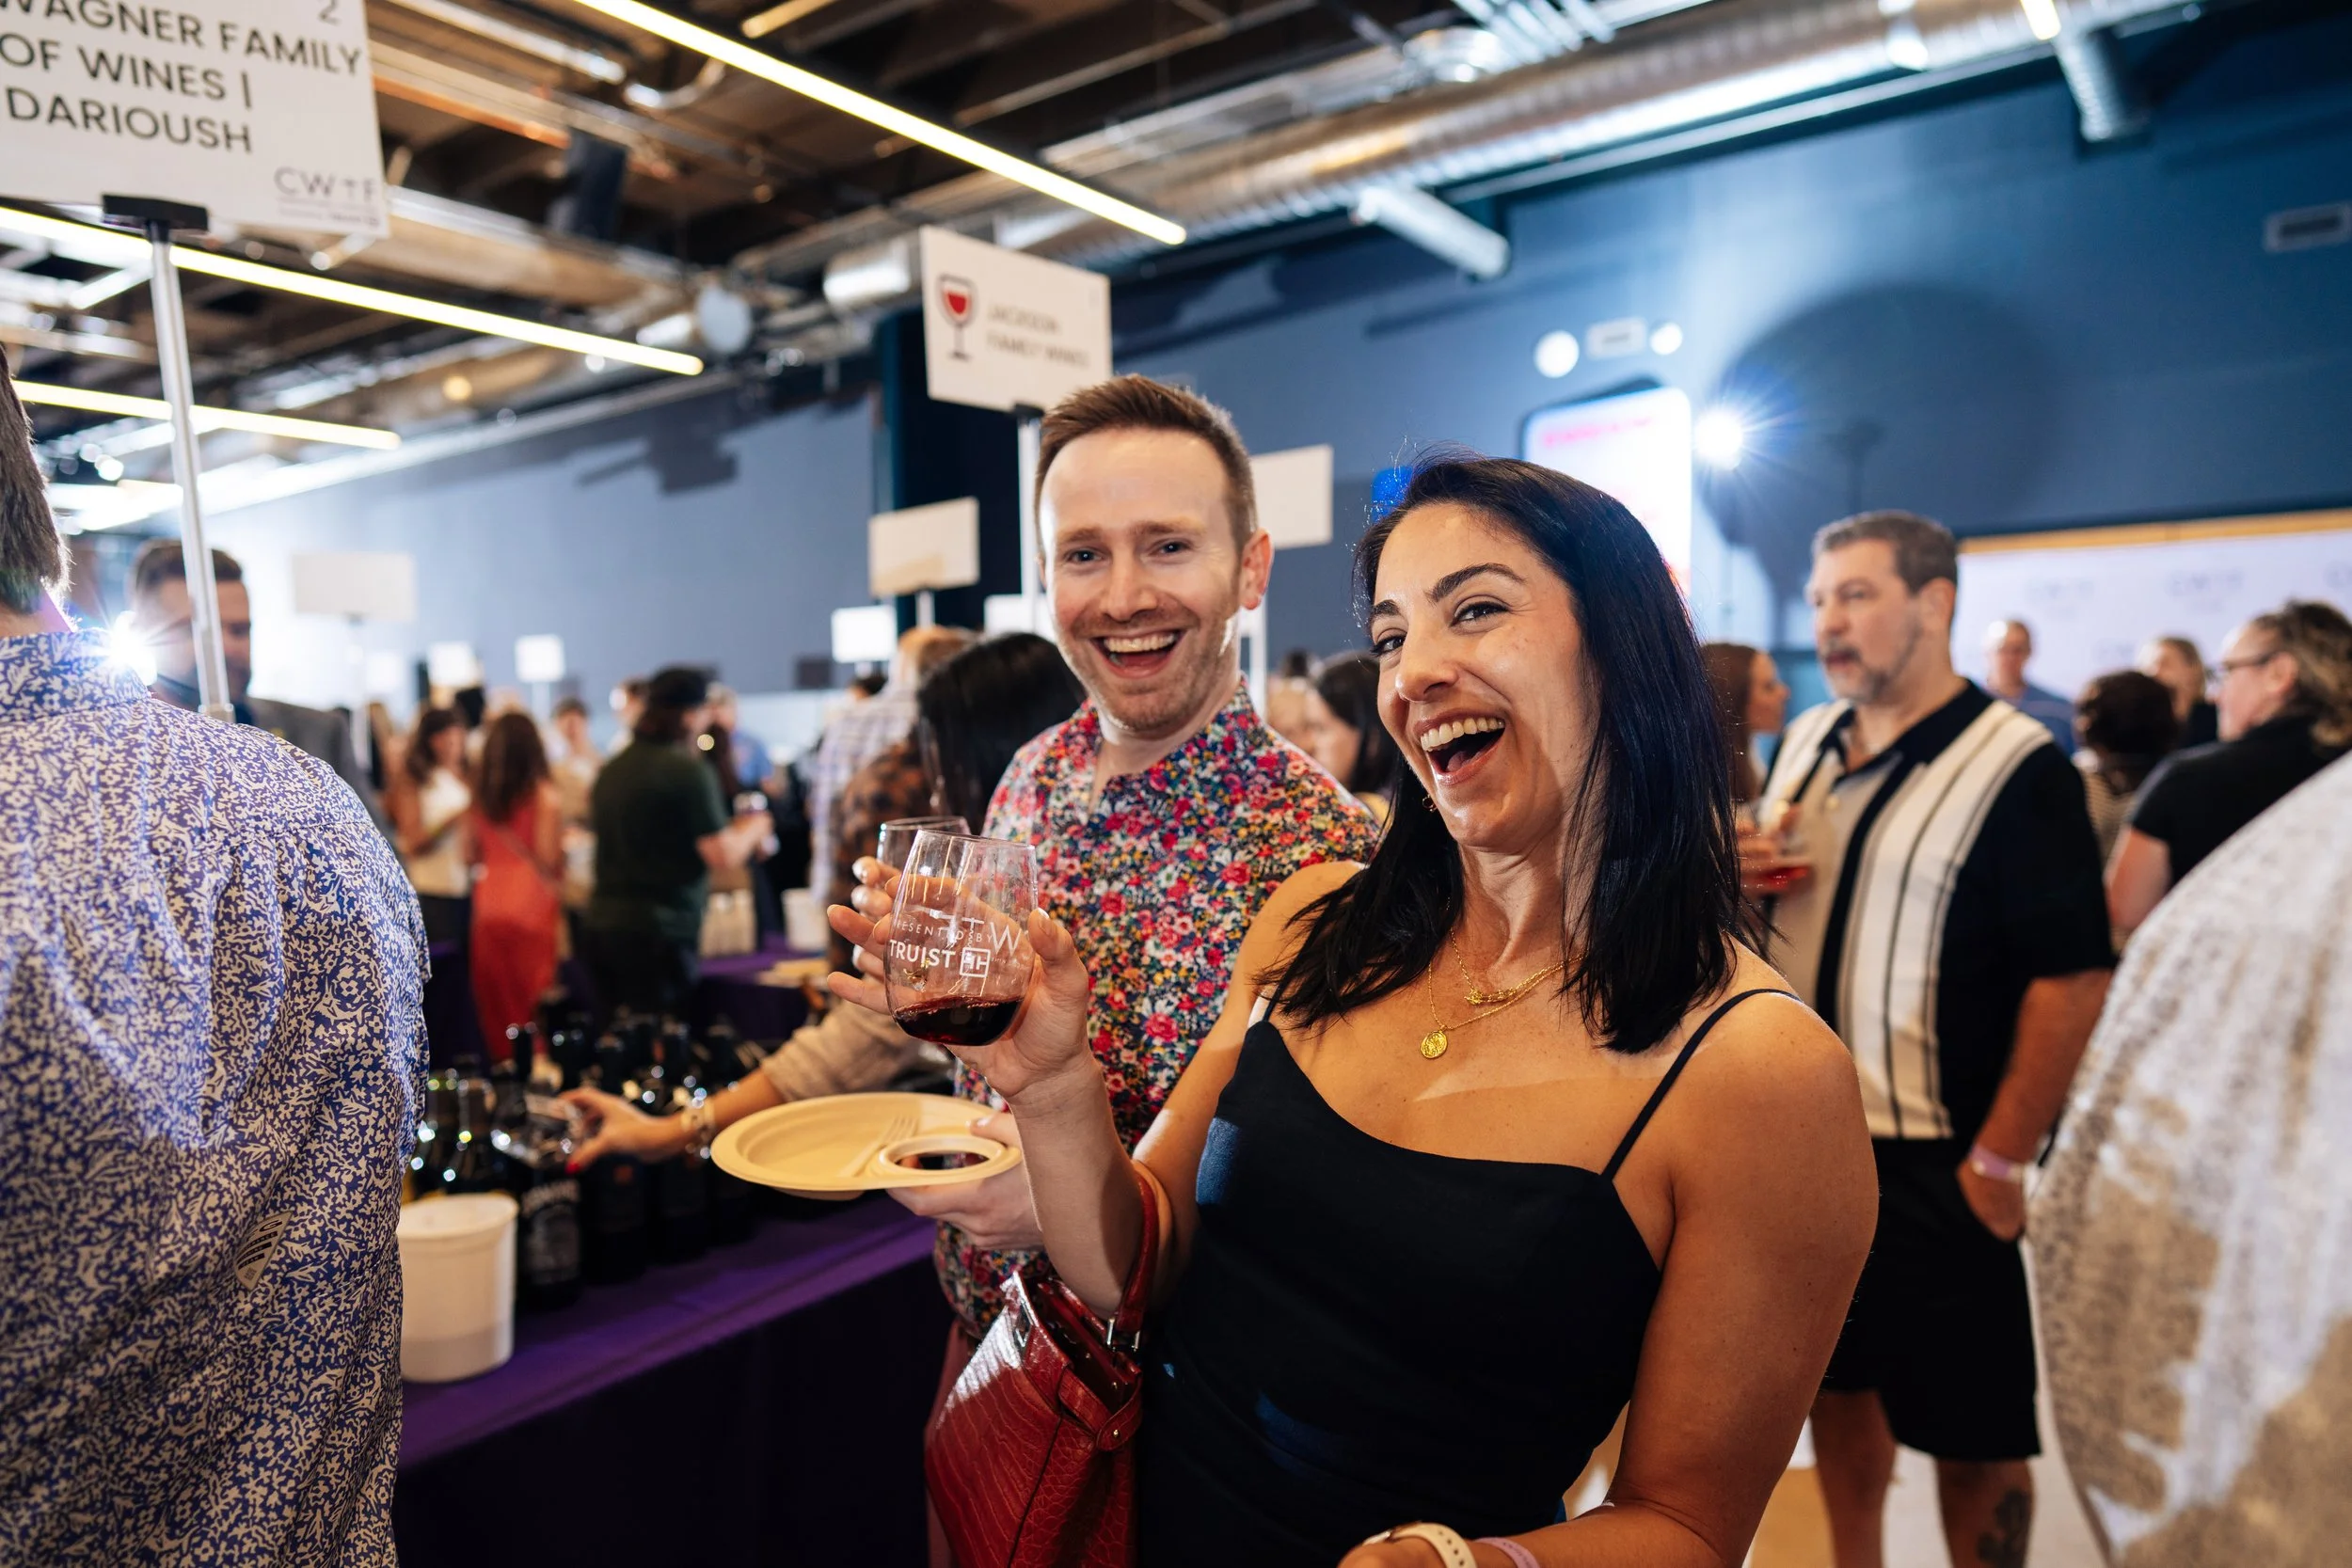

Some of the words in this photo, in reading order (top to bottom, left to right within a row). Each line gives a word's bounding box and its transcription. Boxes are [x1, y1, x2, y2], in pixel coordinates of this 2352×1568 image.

[0, 33, 61, 71] OF
[77, 46, 227, 101] WINES
[219, 20, 362, 76] FAMILY
[6, 86, 252, 153] DARIOUSH
[889, 939, 957, 969] TRUIST
